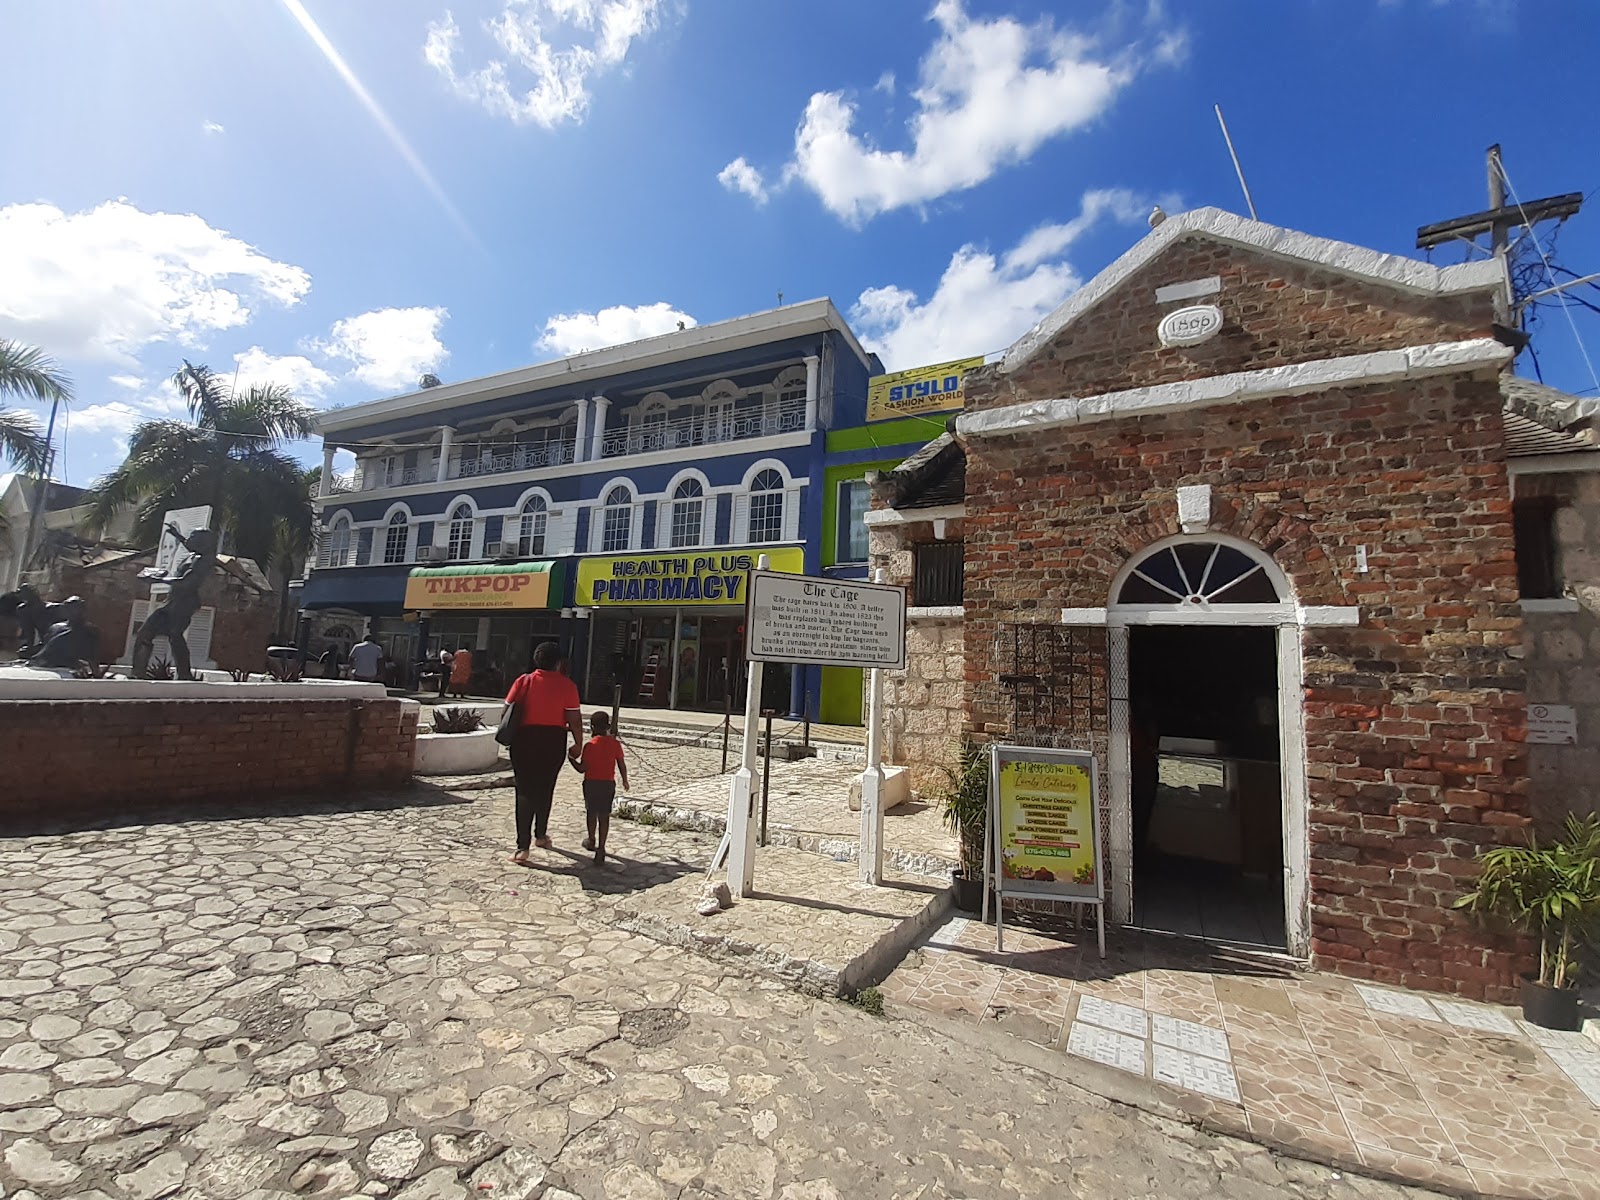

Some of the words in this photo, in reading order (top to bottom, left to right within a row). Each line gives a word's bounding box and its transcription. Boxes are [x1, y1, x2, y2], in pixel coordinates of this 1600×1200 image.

[889, 376, 958, 401] STYLO
[884, 396, 924, 410] FASHION
[928, 391, 963, 402] WORLD
[612, 558, 688, 577] HEALTH
[693, 555, 753, 577] PLUS
[425, 575, 530, 593] TIKPOP
[592, 575, 743, 601] PHARMACY
[803, 584, 826, 597] The
[831, 587, 859, 601] Cage
[773, 595, 786, 603] The
[854, 620, 877, 629] building
[792, 632, 821, 640] overnight
[823, 633, 841, 641] lockup
